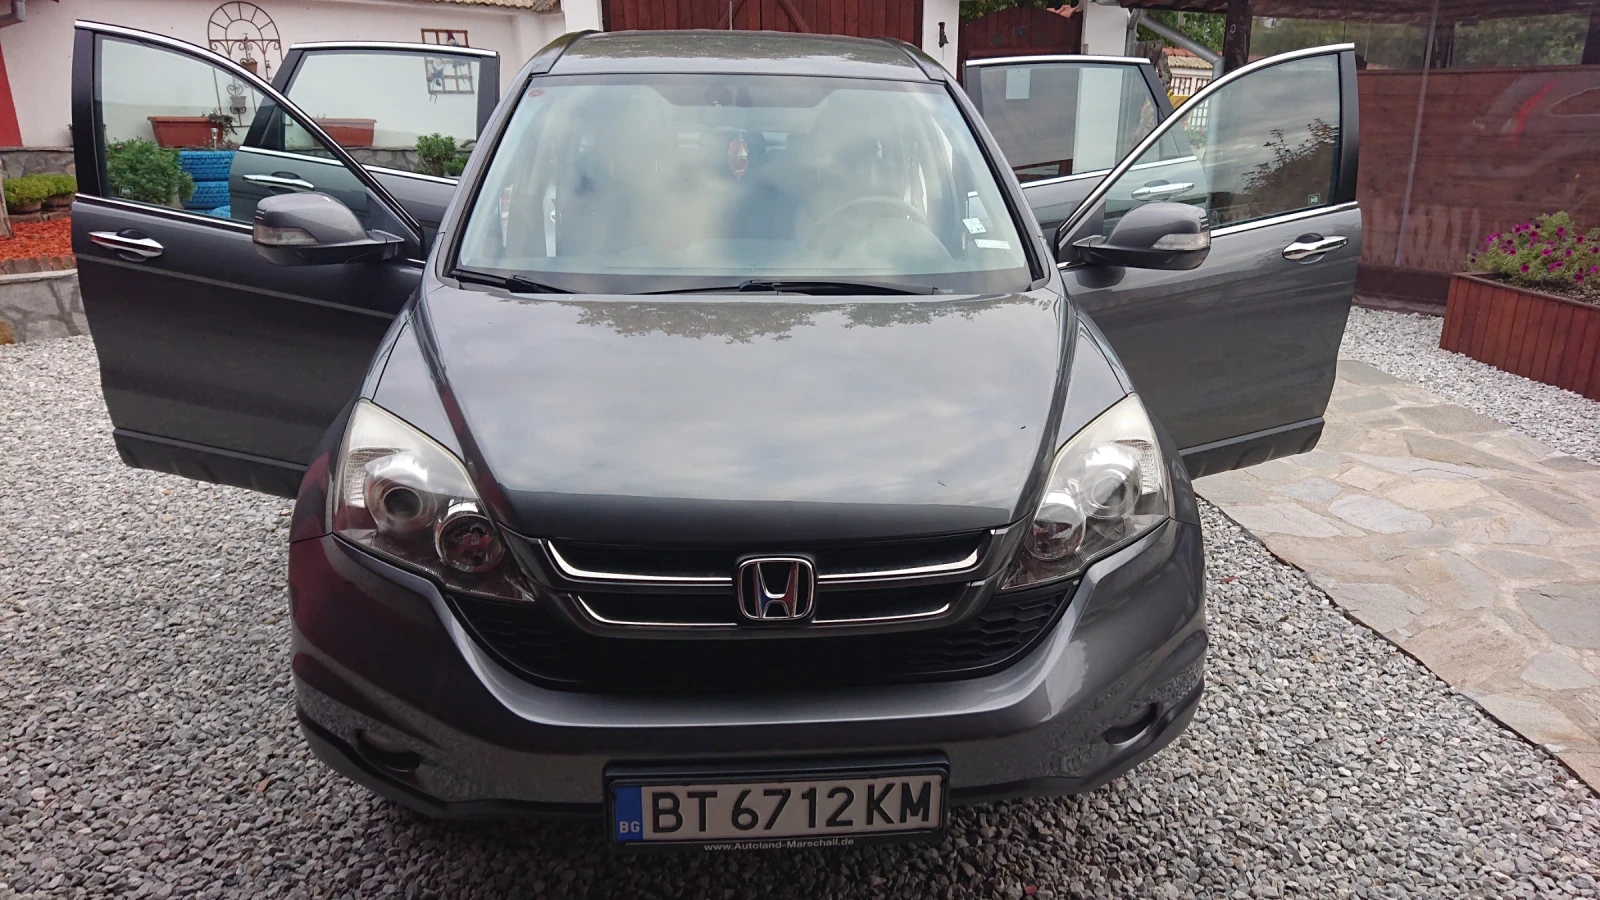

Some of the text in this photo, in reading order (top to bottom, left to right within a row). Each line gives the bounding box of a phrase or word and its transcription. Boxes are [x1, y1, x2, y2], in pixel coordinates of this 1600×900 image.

[652, 781, 932, 834] BT 6712 KM
[619, 820, 641, 834] BG
[704, 837, 855, 851] www.Autoland-Marschall.de
